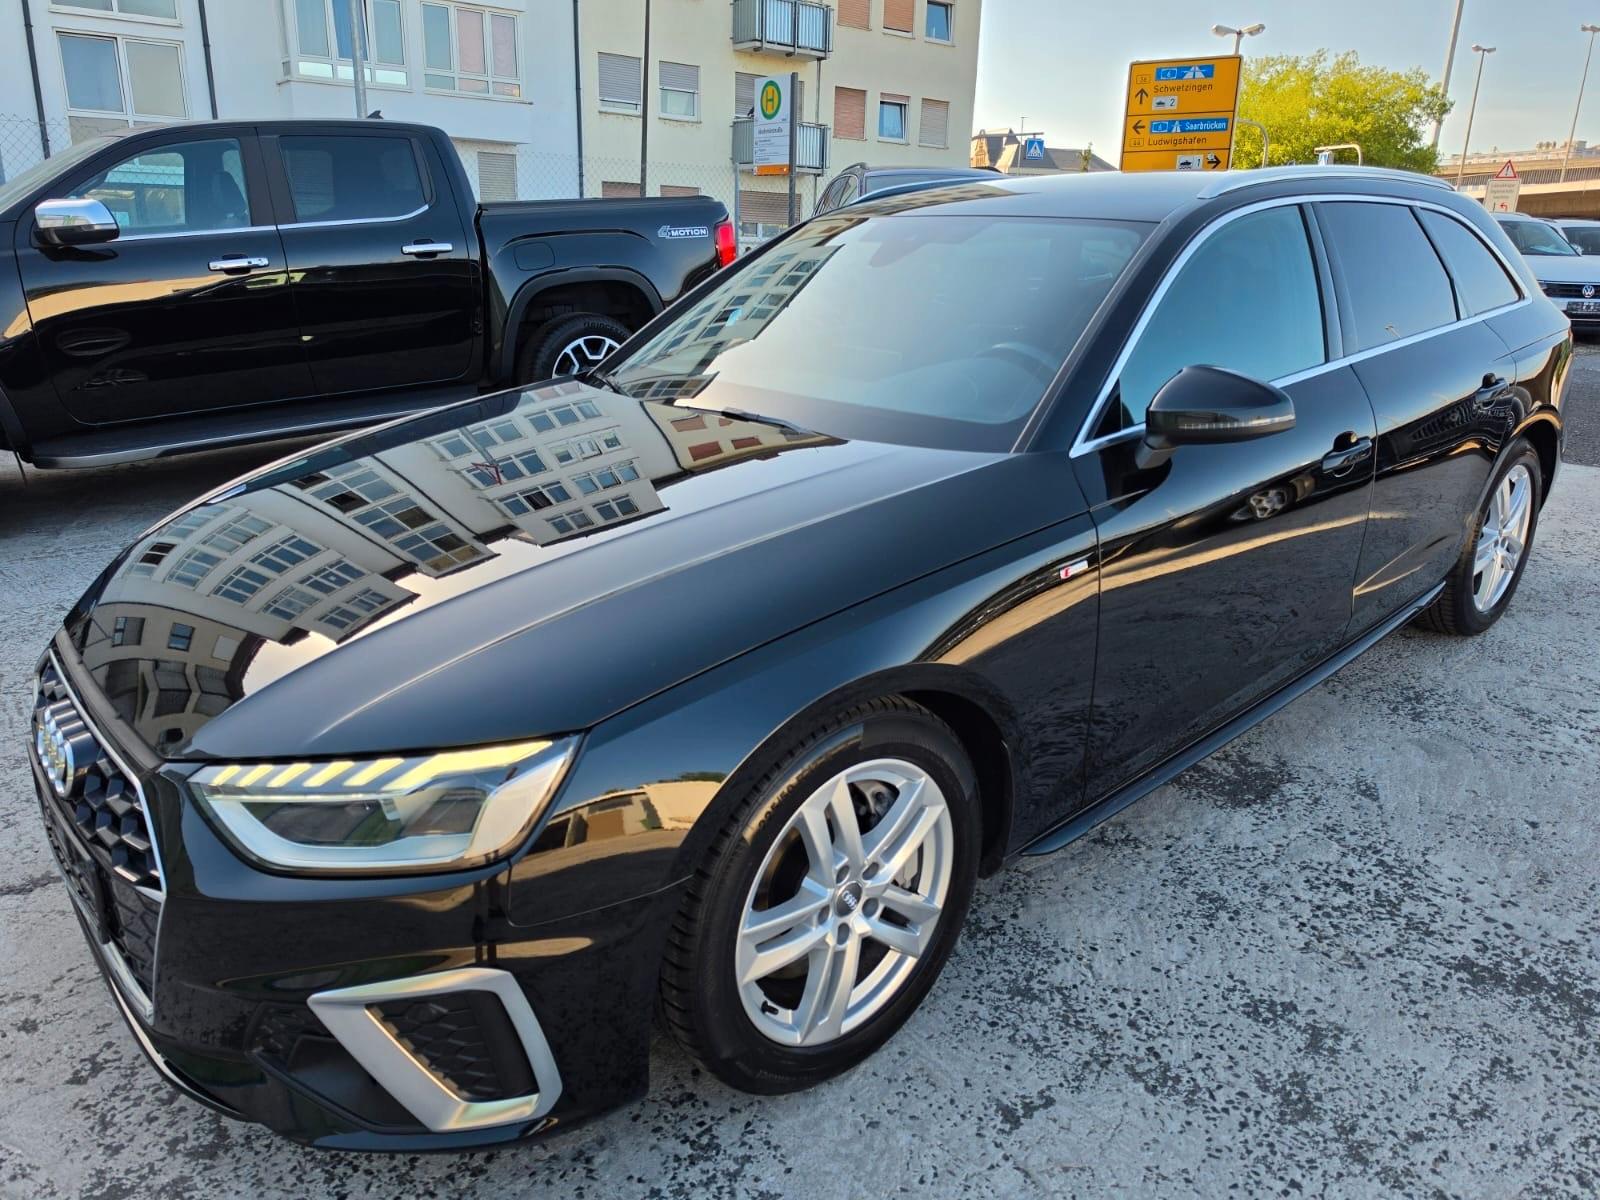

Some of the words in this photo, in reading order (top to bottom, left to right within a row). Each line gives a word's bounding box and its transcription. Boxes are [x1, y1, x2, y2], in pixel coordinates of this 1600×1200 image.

[1153, 83, 1213, 93] Schwetzingen
[765, 87, 775, 112] H
[1169, 98, 1175, 107] 2
[1185, 121, 1226, 131] Saarbrücken
[1148, 136, 1207, 146] Ludwigshafen
[657, 225, 708, 239] 4MOTION
